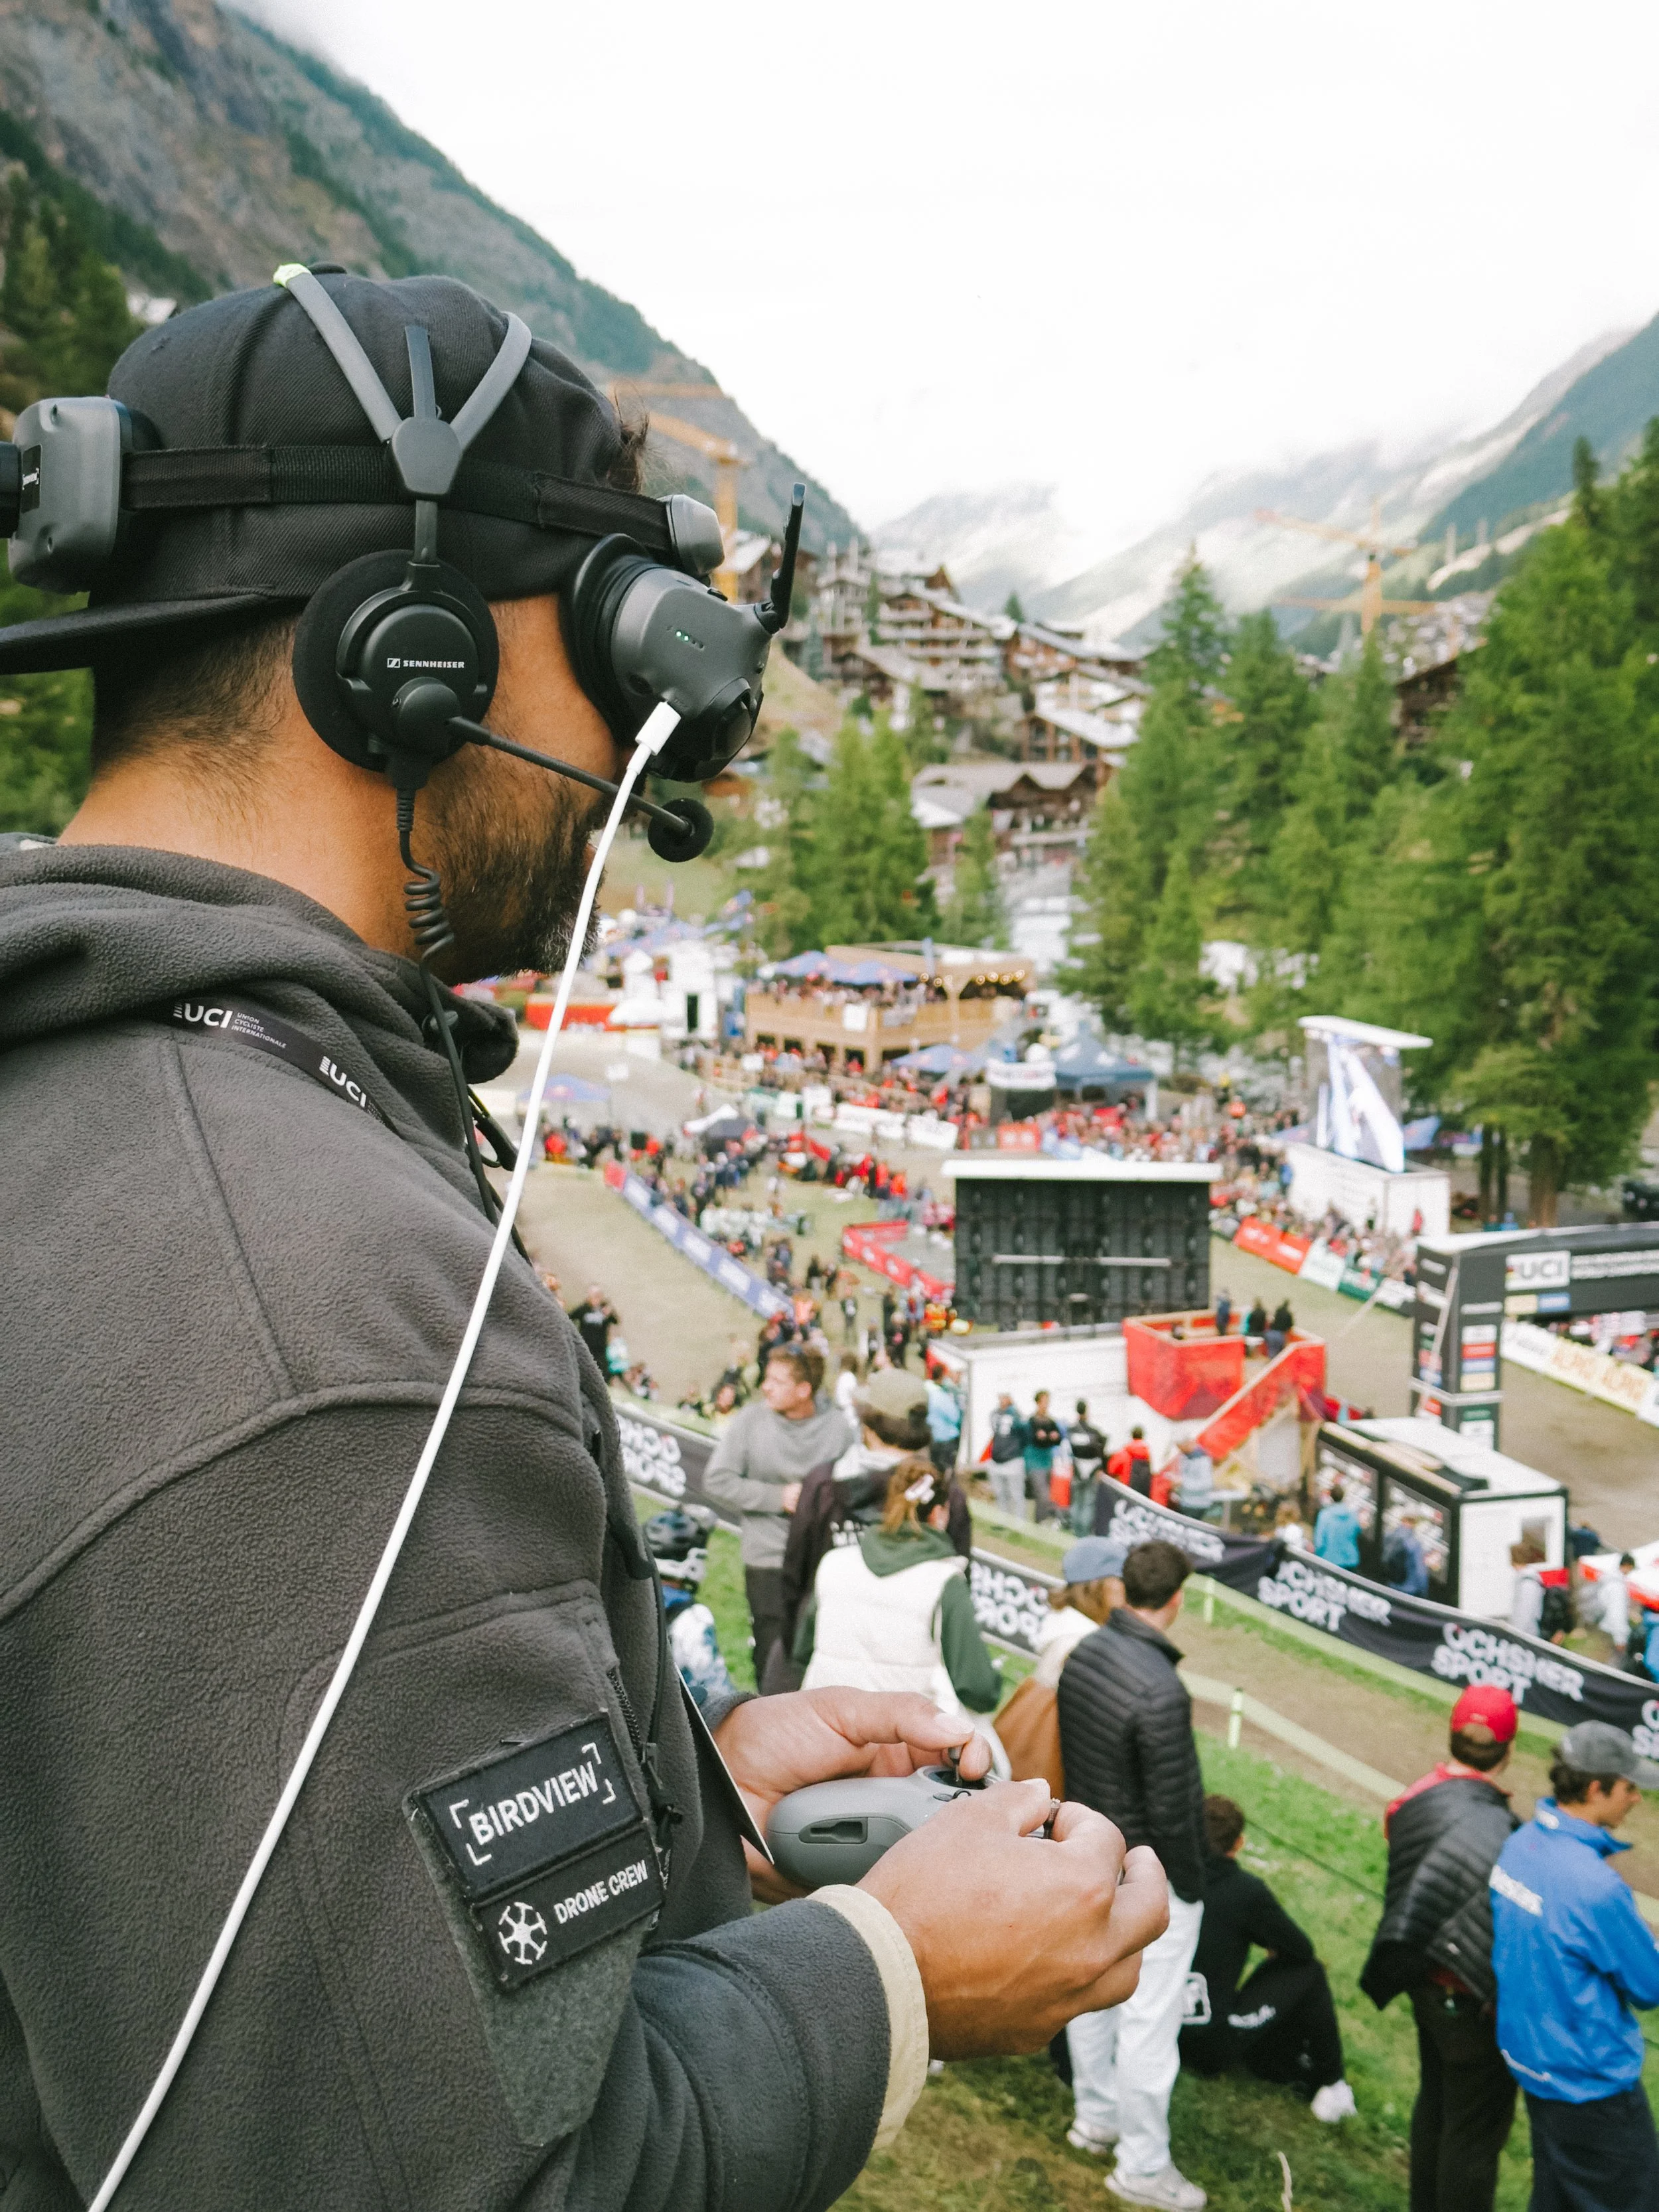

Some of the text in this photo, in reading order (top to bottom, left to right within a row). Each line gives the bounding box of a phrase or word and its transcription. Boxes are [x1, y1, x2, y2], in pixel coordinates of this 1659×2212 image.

[403, 660, 465, 669] SENNHEISER
[184, 1003, 233, 1029] UCI
[234, 1018, 265, 1033] CYCLISTE
[237, 1012, 260, 1024] UNION
[231, 1025, 287, 1049] INTERNATIONALE
[330, 1063, 367, 1108] UCI
[1519, 1258, 1563, 1280] UCI
[1258, 1576, 1346, 1631] SPORT
[1443, 1623, 1585, 1702] OCHSNER
[469, 1761, 599, 1845] BIRDVIEW
[553, 1860, 648, 1924] DRONE CREW
